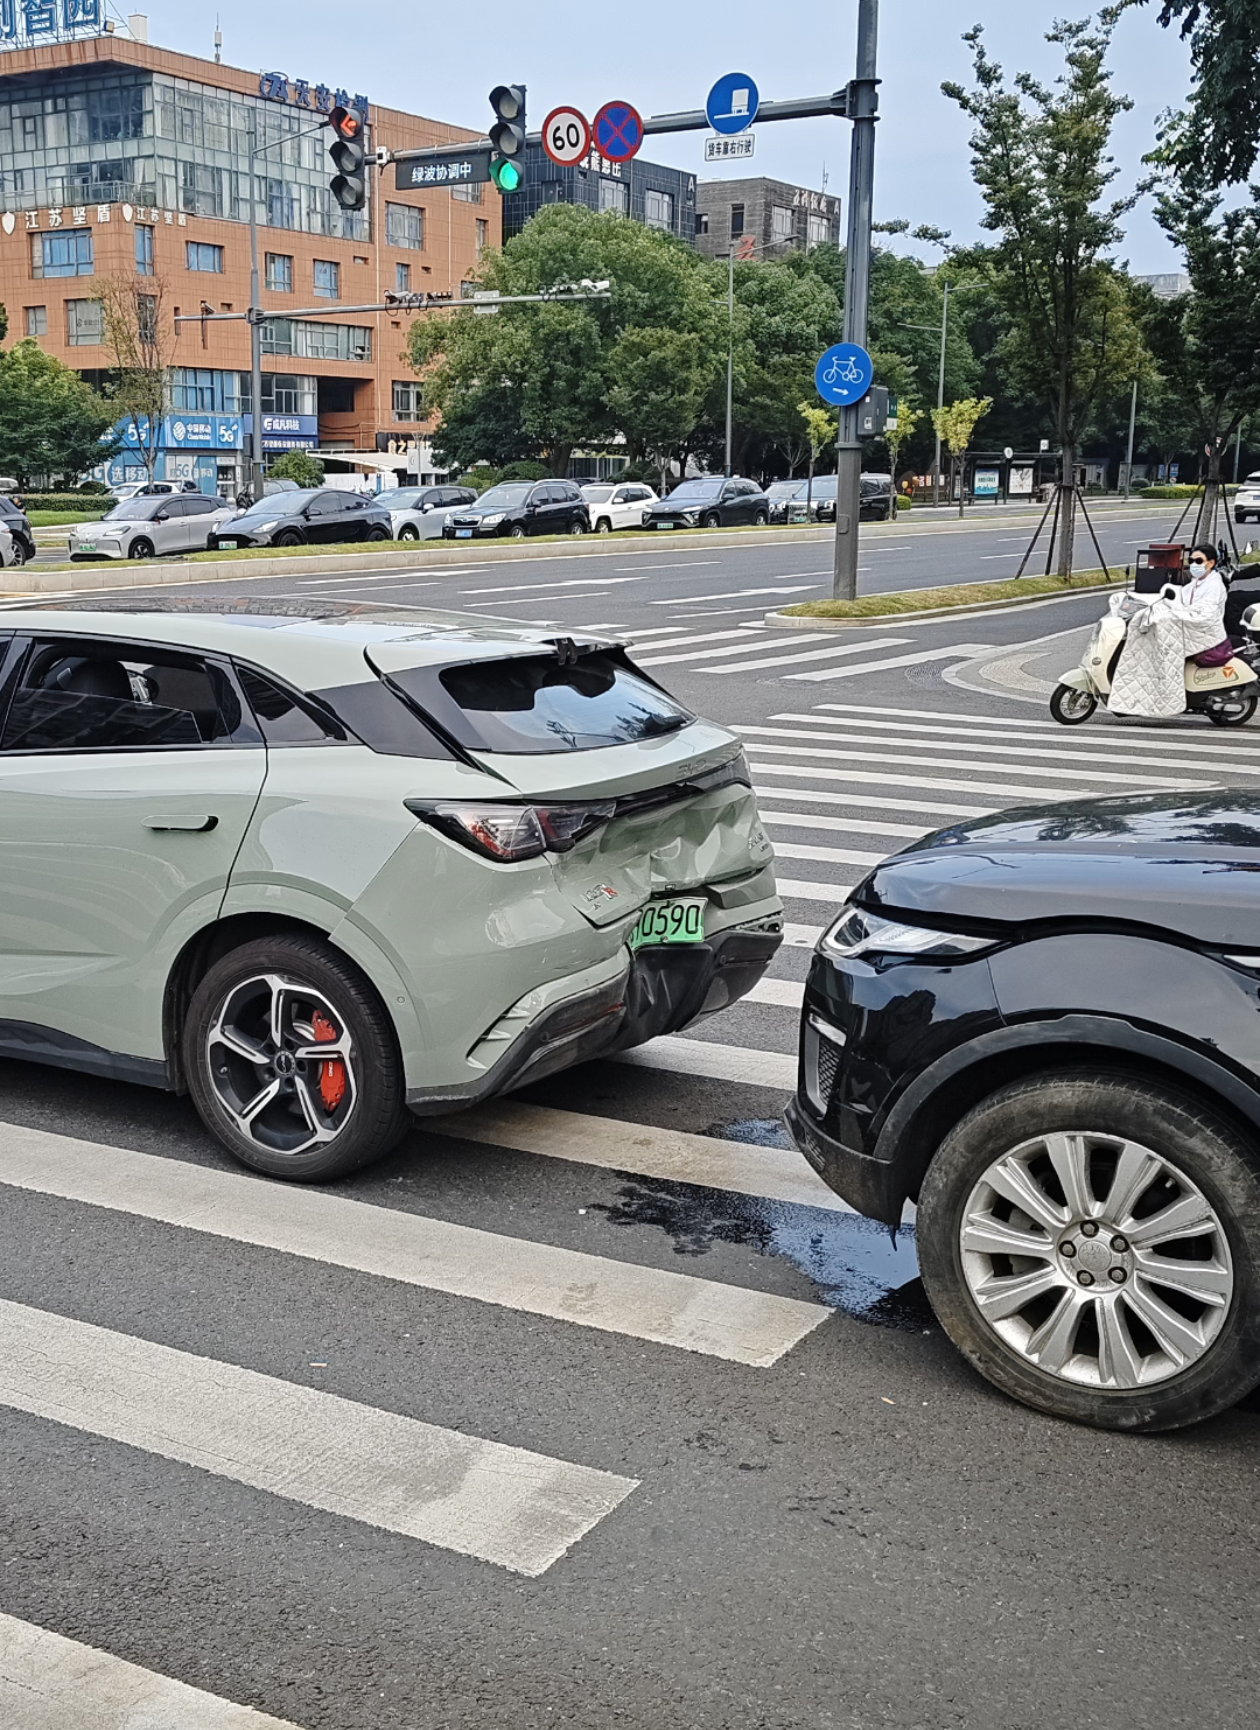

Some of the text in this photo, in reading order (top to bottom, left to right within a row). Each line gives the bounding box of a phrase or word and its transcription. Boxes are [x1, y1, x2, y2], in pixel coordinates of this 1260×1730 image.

[552, 122, 580, 151] 60
[707, 138, 752, 157] 货车靠右行驶
[411, 161, 472, 183] 绿波协调中
[25, 204, 111, 229] 江苏坚盾
[136, 207, 187, 227] 江苏坚盾
[218, 425, 235, 443] 5G
[630, 904, 701, 942] 0590
